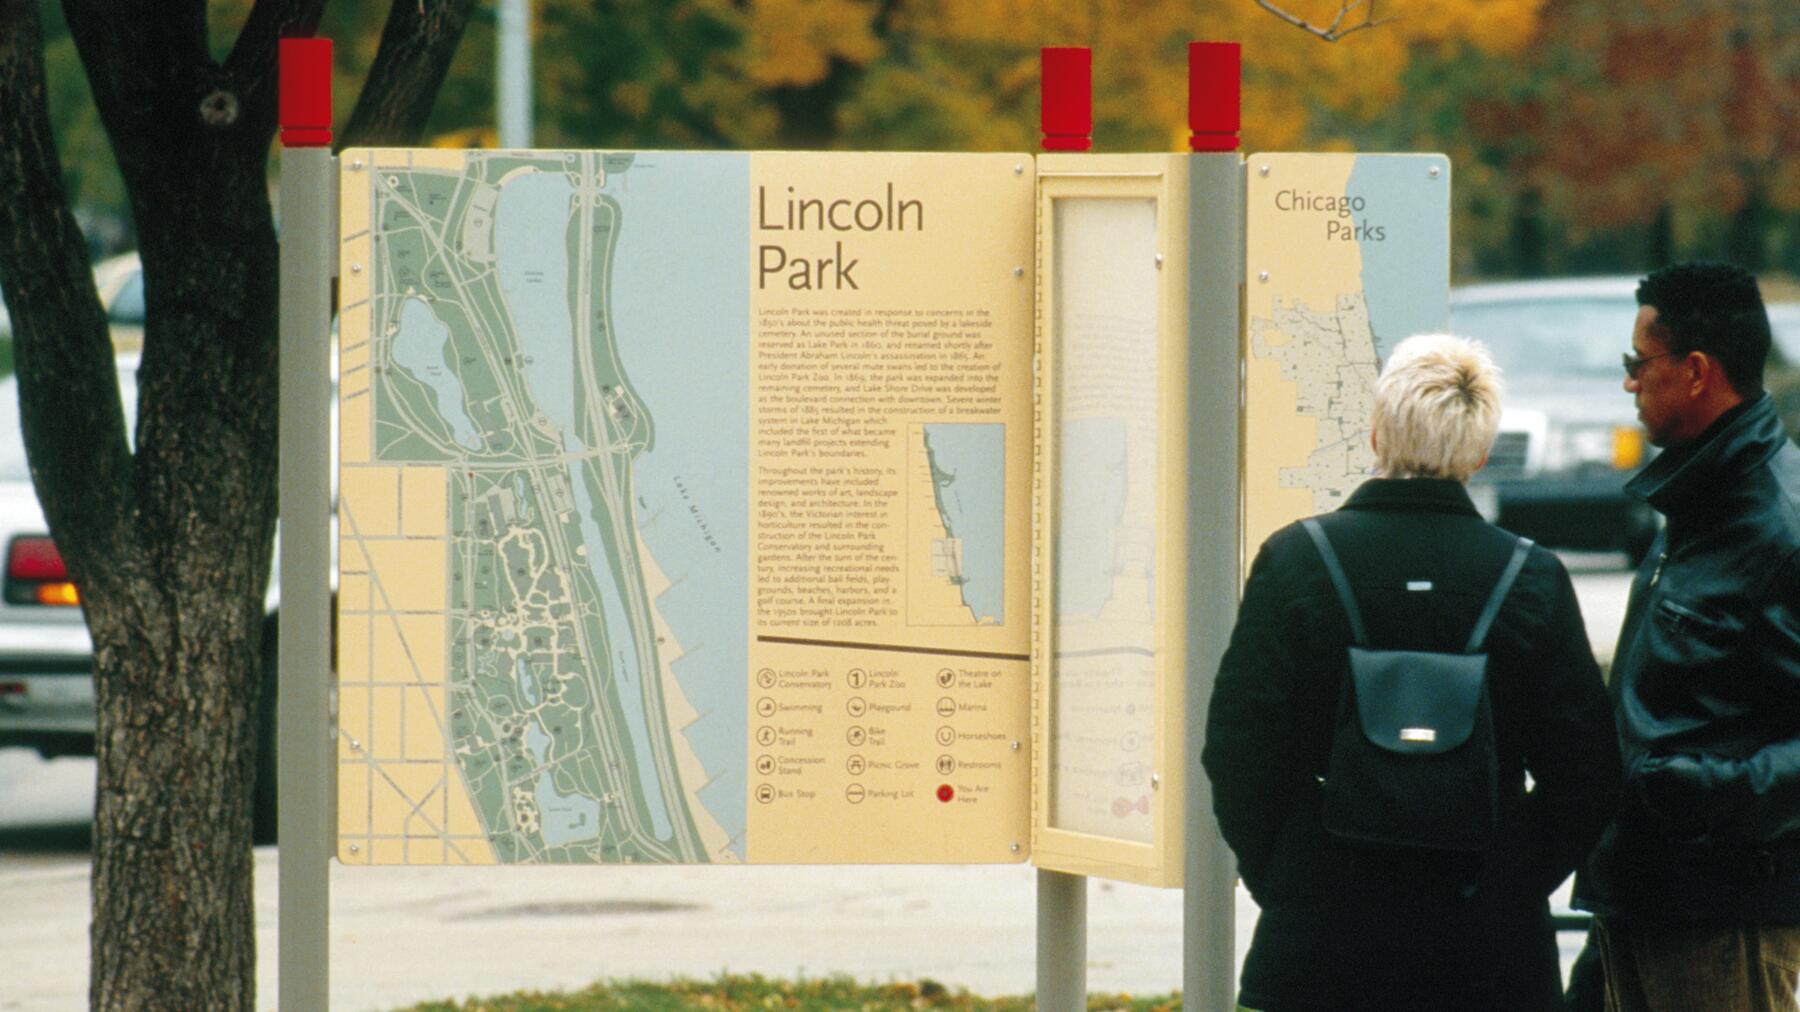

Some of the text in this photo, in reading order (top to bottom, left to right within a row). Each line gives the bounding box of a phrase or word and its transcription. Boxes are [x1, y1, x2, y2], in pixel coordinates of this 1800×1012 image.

[759, 182, 924, 231] Lincoln
[1275, 189, 1366, 218] Chicago
[1327, 219, 1387, 241] Parks
[759, 241, 859, 290] Park
[673, 475, 721, 552] Lake Michigan
[778, 670, 829, 678] Lincoln Park
